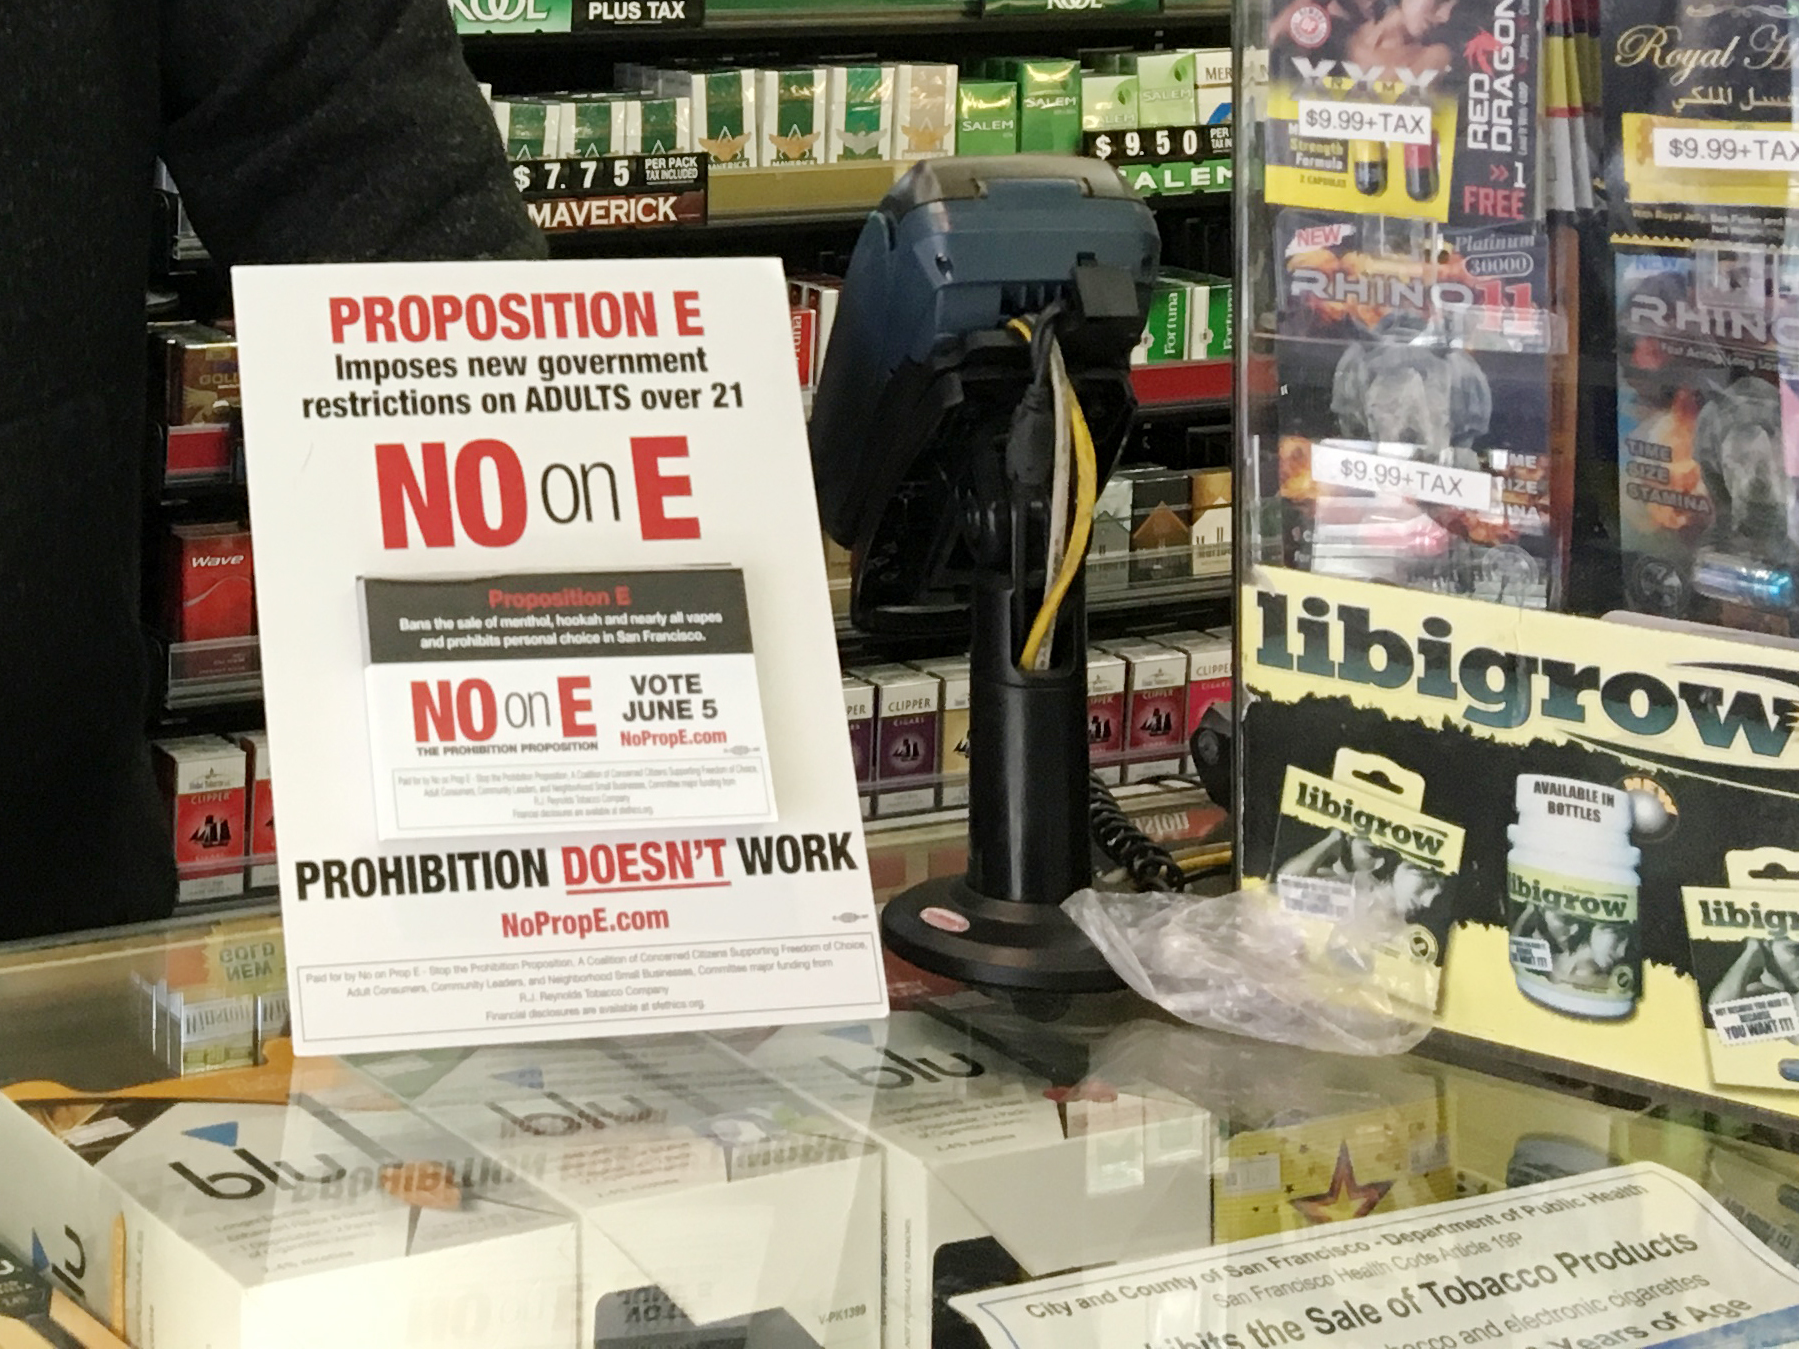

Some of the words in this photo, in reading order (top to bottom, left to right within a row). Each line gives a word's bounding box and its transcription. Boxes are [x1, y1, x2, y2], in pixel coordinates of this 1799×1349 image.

[588, 1, 642, 20] PLUS
[647, 0, 685, 20] TAX
[1614, 24, 1741, 87] Royal
[962, 120, 1014, 132] SALEM
[1305, 107, 1425, 135] $9.99+TAX
[1467, 73, 1489, 150] RED
[645, 157, 666, 170] PER
[669, 156, 697, 168] PACK
[527, 196, 678, 229] MAVERICK
[1463, 185, 1525, 221] FREE
[1455, 233, 1535, 252] Platinum
[1470, 257, 1528, 275] 30000
[1290, 269, 1474, 313] RHINO
[329, 291, 658, 344] PROPOSITION
[673, 291, 705, 337] E
[1163, 287, 1182, 356] Fortuna
[335, 354, 458, 386] Imposes
[468, 355, 527, 379] new
[538, 347, 708, 381] government
[302, 388, 471, 418] restrictions
[482, 390, 516, 414] on
[525, 385, 631, 414] ADULTS
[641, 386, 701, 411] over
[711, 383, 745, 409] 21
[374, 438, 529, 550] NO
[540, 461, 621, 524] on
[629, 435, 702, 541] E
[190, 553, 245, 569] Wave
[489, 587, 610, 611] Proposition
[615, 585, 632, 606] E
[400, 618, 431, 632] Bans
[433, 616, 454, 630] the
[457, 616, 483, 630] sale
[485, 616, 498, 629] of
[500, 614, 554, 629] menthol,
[556, 613, 602, 627] hookah
[604, 613, 628, 626] and
[630, 612, 667, 627] nearly
[669, 611, 683, 625] all
[686, 612, 722, 626] vapes
[420, 636, 445, 649] and
[447, 634, 501, 649] prohibits
[503, 632, 557, 649] personal
[559, 630, 600, 645] choice
[603, 630, 614, 644] in
[617, 630, 640, 643] San
[643, 629, 707, 644] Francisco.
[630, 674, 703, 695] VOTE
[1256, 590, 1799, 758] libigrow
[410, 677, 498, 743] NO
[505, 691, 551, 729] on
[557, 675, 597, 738] E
[623, 700, 694, 722] JUNE
[702, 699, 718, 719] 5
[888, 695, 933, 712] CLIPPER
[417, 746, 440, 756] THE
[443, 744, 518, 755] PROHIBITION
[520, 741, 598, 753] PROPOSITION
[620, 729, 727, 748] NoPropE.com
[1533, 780, 1599, 805] AVAILABLE
[1601, 792, 1616, 808] IN
[1295, 781, 1445, 858] libigrow
[1547, 801, 1602, 824] BOTTLES
[296, 847, 550, 901] PROHIBITION
[562, 837, 731, 893] DOESN'T
[739, 831, 859, 876] WORK
[501, 908, 670, 940] NoPropE.com
[168, 1146, 349, 1203] blu
[1025, 1300, 1074, 1320] City
[1075, 1293, 1118, 1311] and
[1121, 1276, 1196, 1306] County
[1201, 1268, 1223, 1285] of
[1223, 1260, 1271, 1283] San
[1271, 1238, 1371, 1272] Francisco
[1380, 1214, 1501, 1249] Department
[1501, 1207, 1525, 1223] of
[1524, 1197, 1586, 1219] Public
[1586, 1183, 1649, 1207] Health
[1213, 1290, 1252, 1311] San
[1252, 1272, 1335, 1304] Francisco
[1337, 1258, 1392, 1285] Health
[1390, 1249, 1439, 1271] Code
[1440, 1240, 1492, 1262] Article
[1491, 1231, 1524, 1252] 19P
[1305, 1295, 1384, 1338] Sale
[1386, 1283, 1424, 1319] of
[1418, 1265, 1559, 1310] Tobacco
[1553, 1230, 1700, 1279] Products
[1457, 1321, 1504, 1348] and
[1504, 1296, 1607, 1335] electronic
[1608, 1272, 1712, 1309] cigarettes
